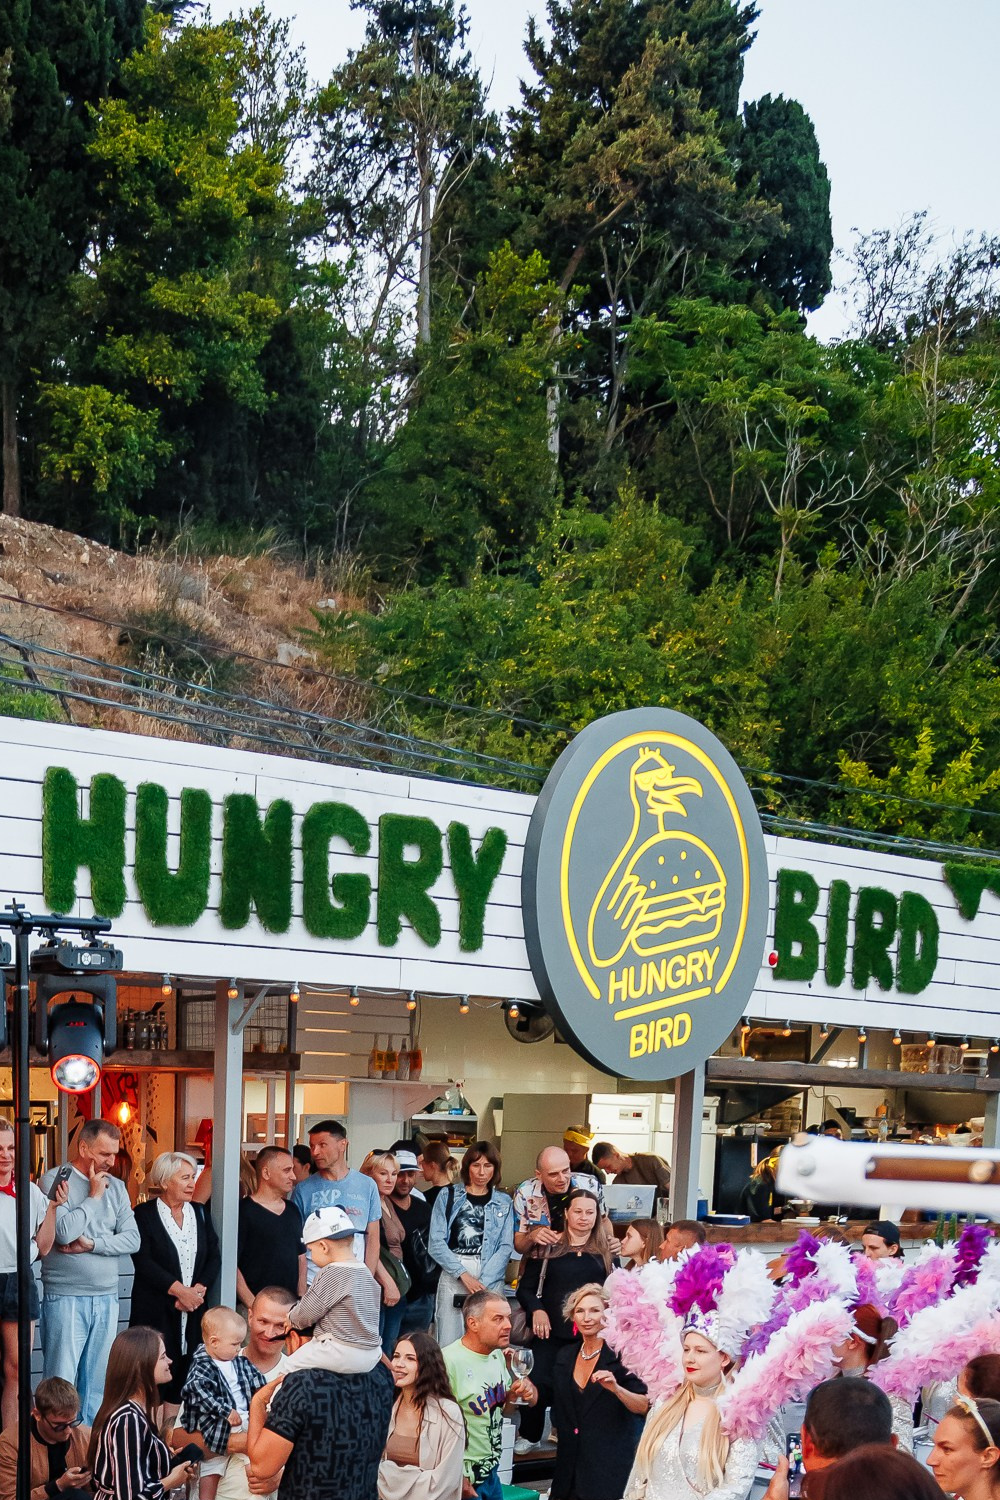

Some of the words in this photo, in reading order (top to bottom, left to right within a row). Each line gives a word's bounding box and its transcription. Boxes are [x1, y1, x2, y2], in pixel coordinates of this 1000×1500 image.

[42, 766, 508, 952] HUNGRY
[773, 868, 940, 994] BIRD
[607, 945, 721, 1004] HUNGRY
[628, 1012, 693, 1058] BIRD
